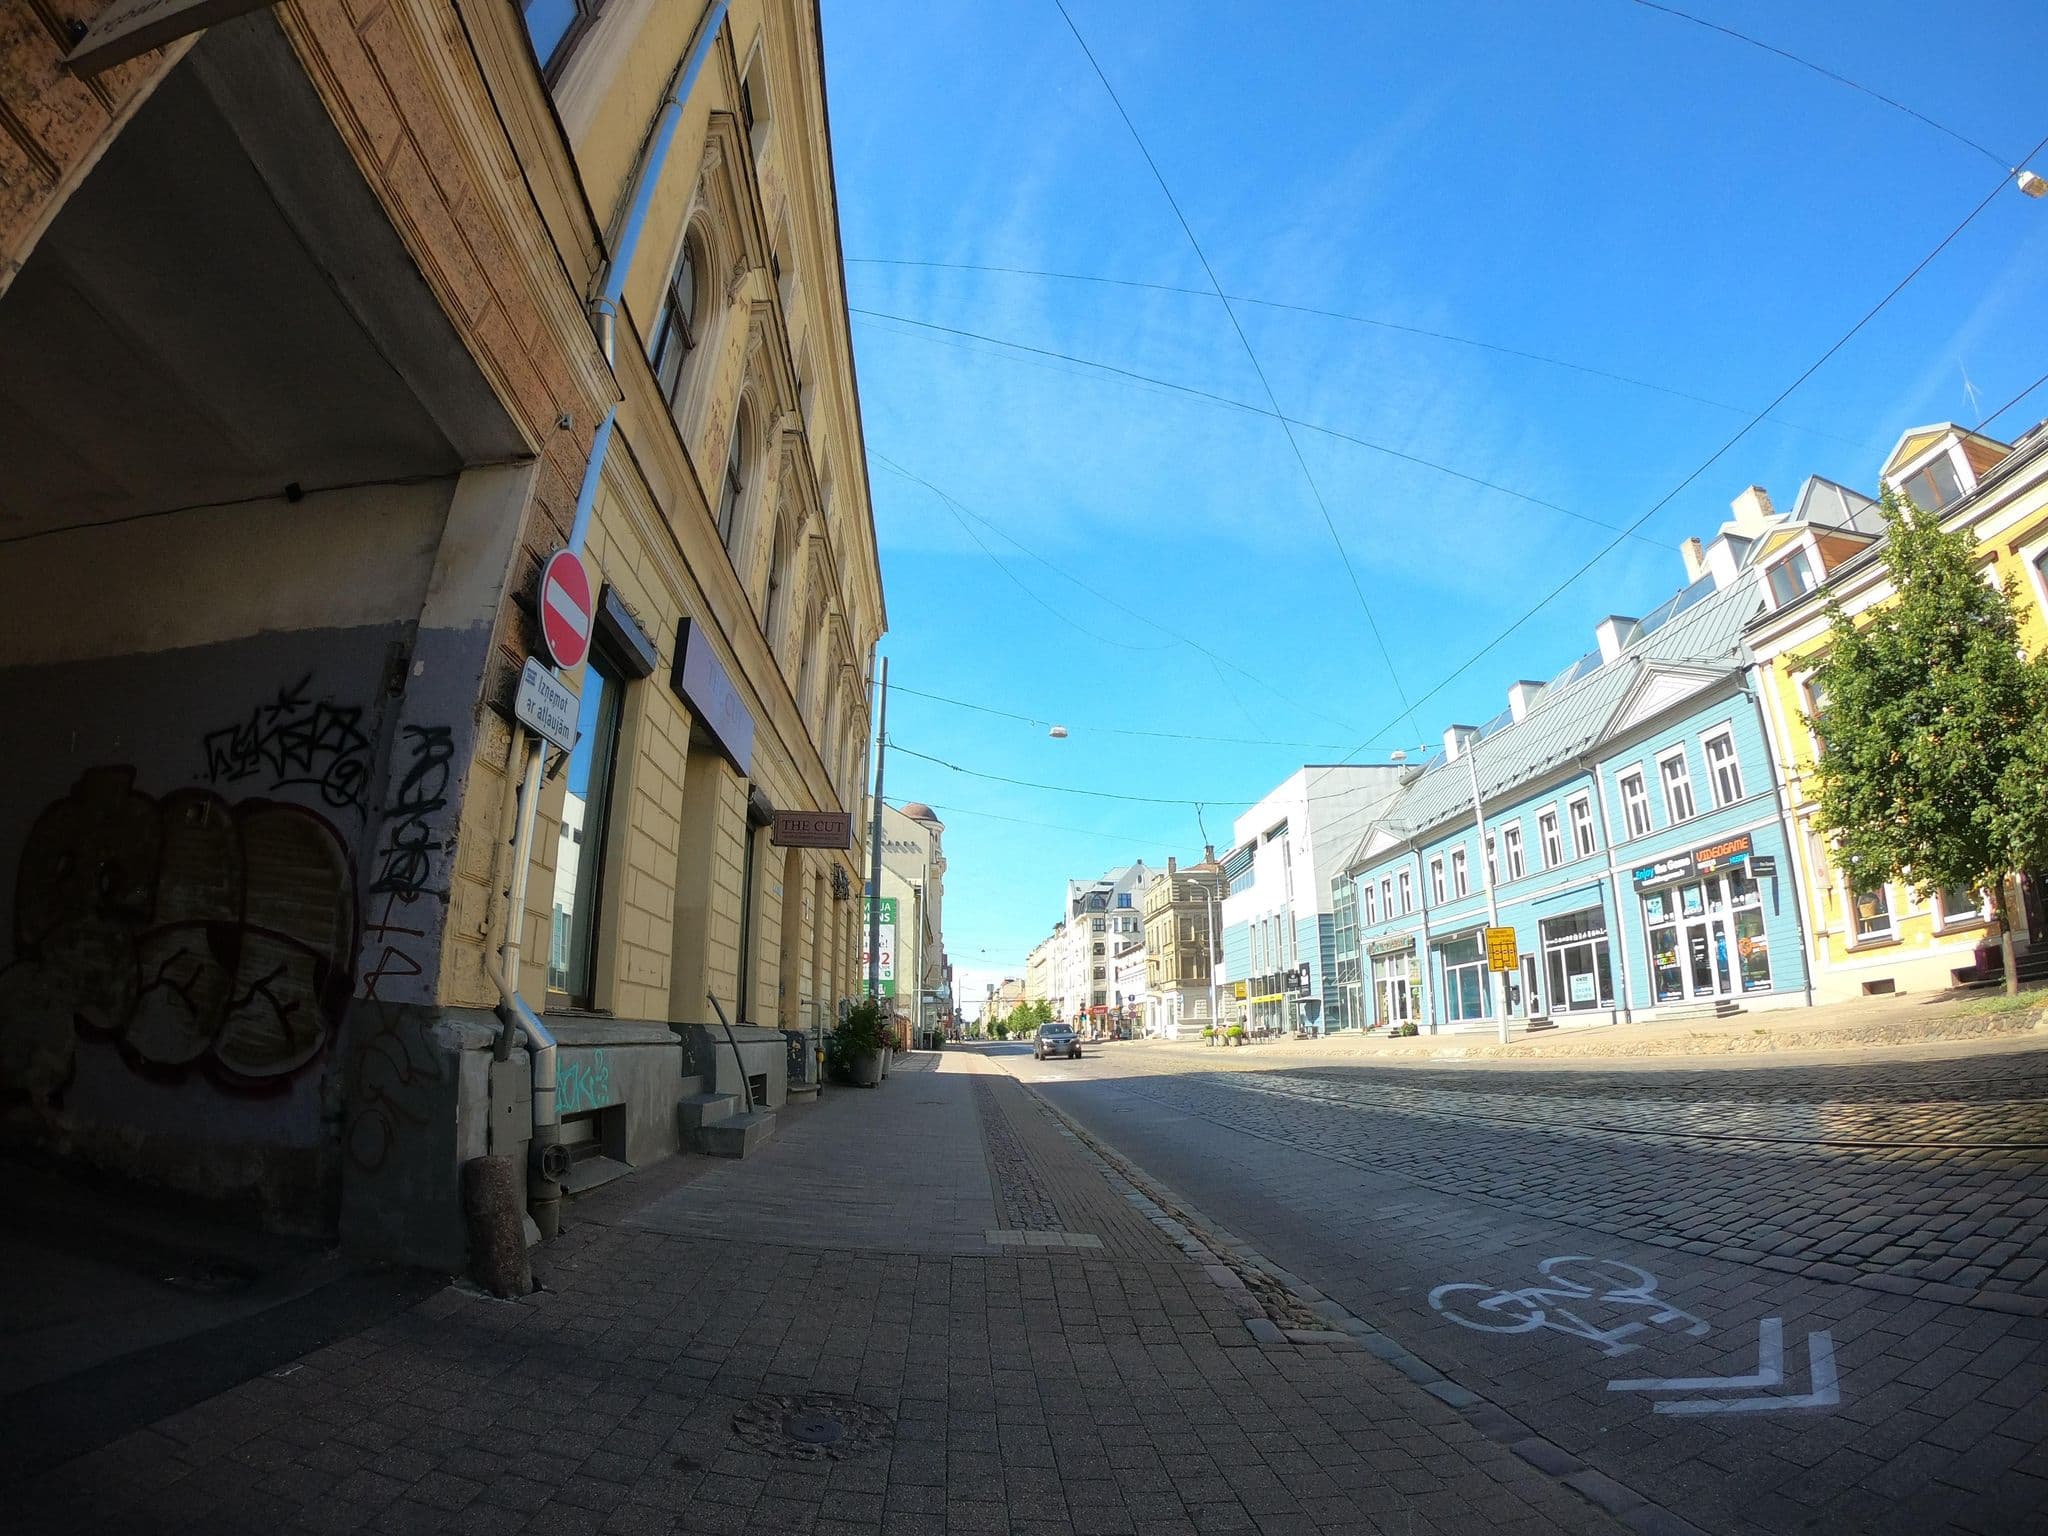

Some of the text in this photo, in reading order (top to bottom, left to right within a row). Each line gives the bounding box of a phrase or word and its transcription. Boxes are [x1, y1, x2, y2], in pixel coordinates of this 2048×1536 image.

[538, 675, 569, 713] Izņemot
[526, 698, 571, 740] ar atļaujām
[784, 820, 844, 832] THE CUT
[1696, 838, 1748, 861] VIDEOGAME
[1635, 867, 1654, 880] Enjoy
